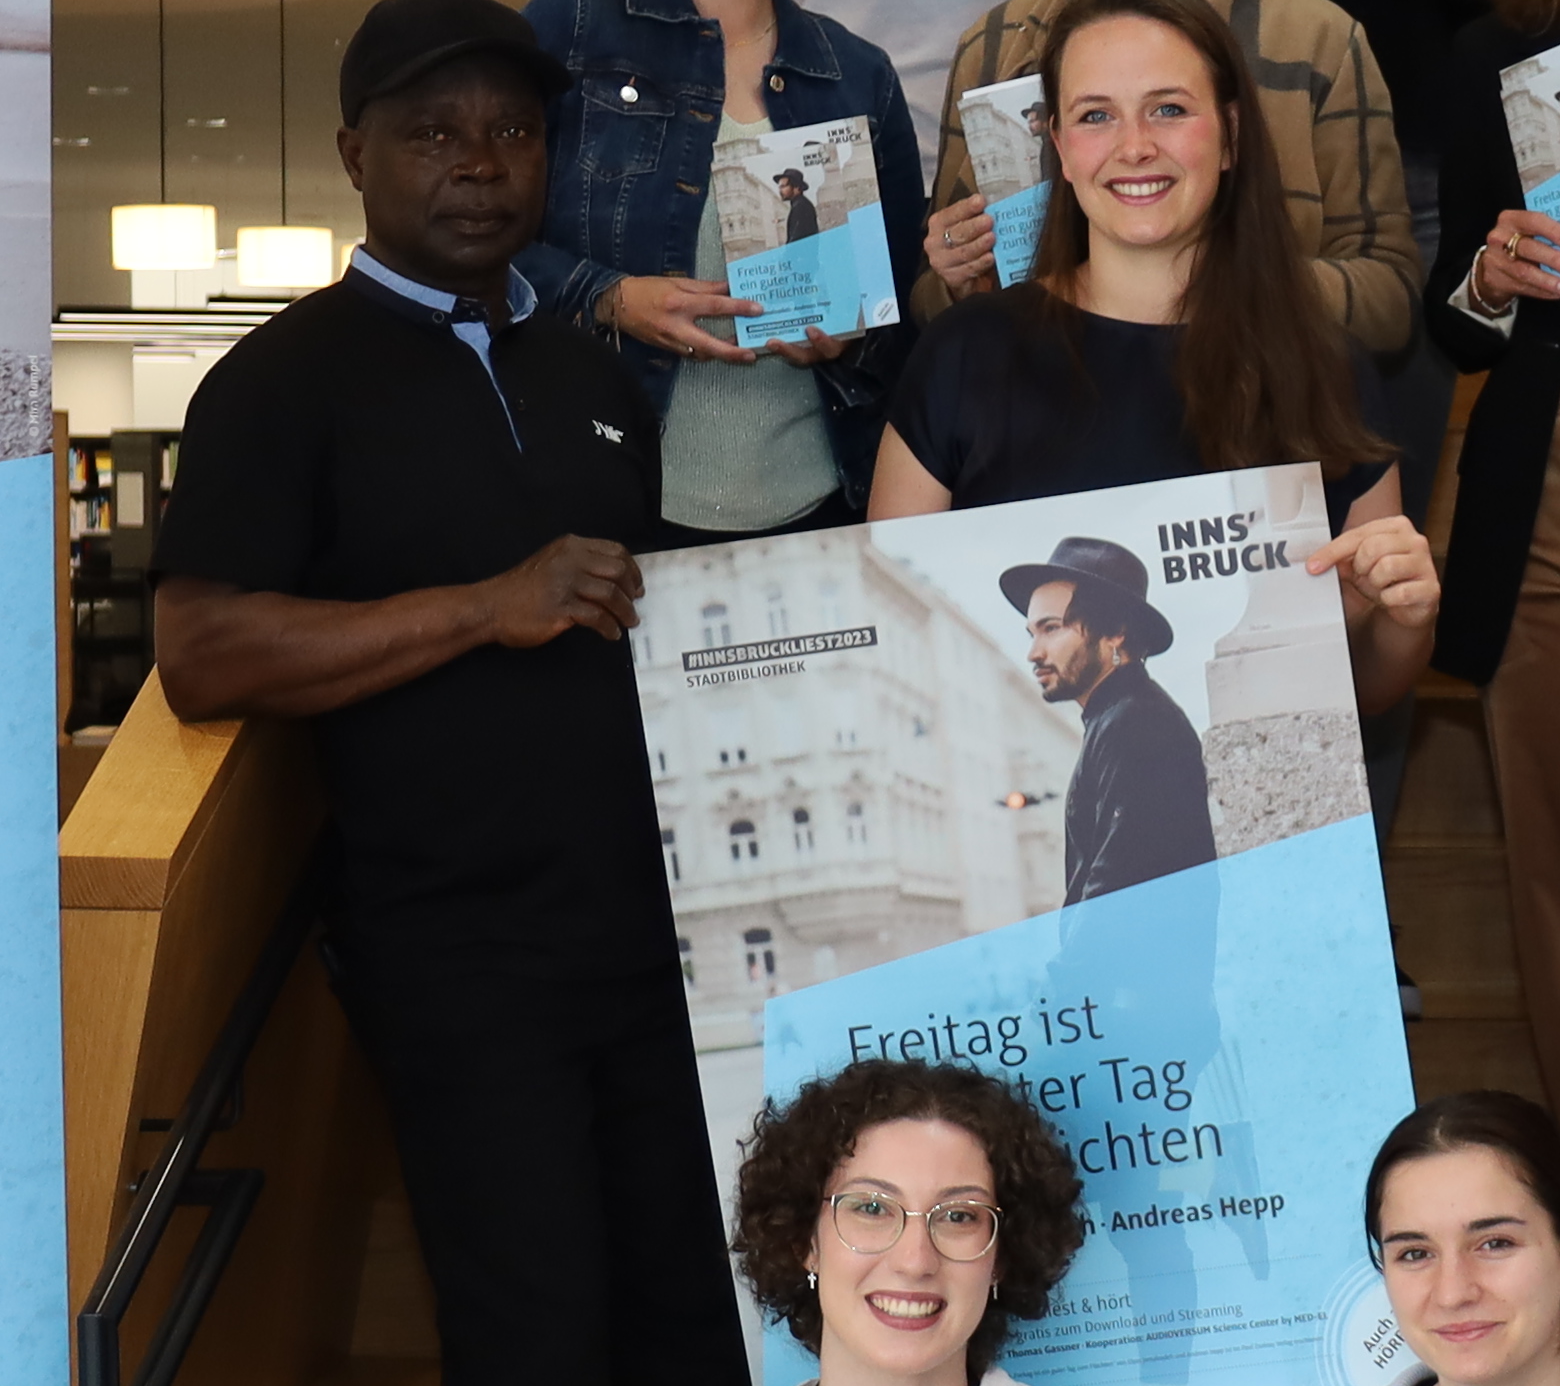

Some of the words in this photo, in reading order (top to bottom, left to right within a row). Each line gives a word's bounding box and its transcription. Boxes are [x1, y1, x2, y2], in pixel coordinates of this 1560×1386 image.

[1163, 540, 1289, 584] BRUCK
[688, 628, 872, 669] #INNSBRUCKLIEST2023
[687, 661, 806, 687] STADTBIBLIOTHEK
[848, 1011, 1025, 1066] Freitag
[1039, 996, 1103, 1045] ist
[1100, 1059, 1192, 1111] Tag
[1111, 1200, 1213, 1235] Andreas
[1219, 1191, 1285, 1221] Hepp
[1055, 1324, 1081, 1337] zum
[1085, 1315, 1146, 1333] Download
[1151, 1310, 1175, 1324] und
[1179, 1303, 1243, 1322] Streaming
[1097, 1293, 1132, 1311] hört
[1007, 1347, 1042, 1359] Thomas
[1146, 1326, 1211, 1341] AUDIOVERSUM
[1362, 1317, 1393, 1353] Auch
